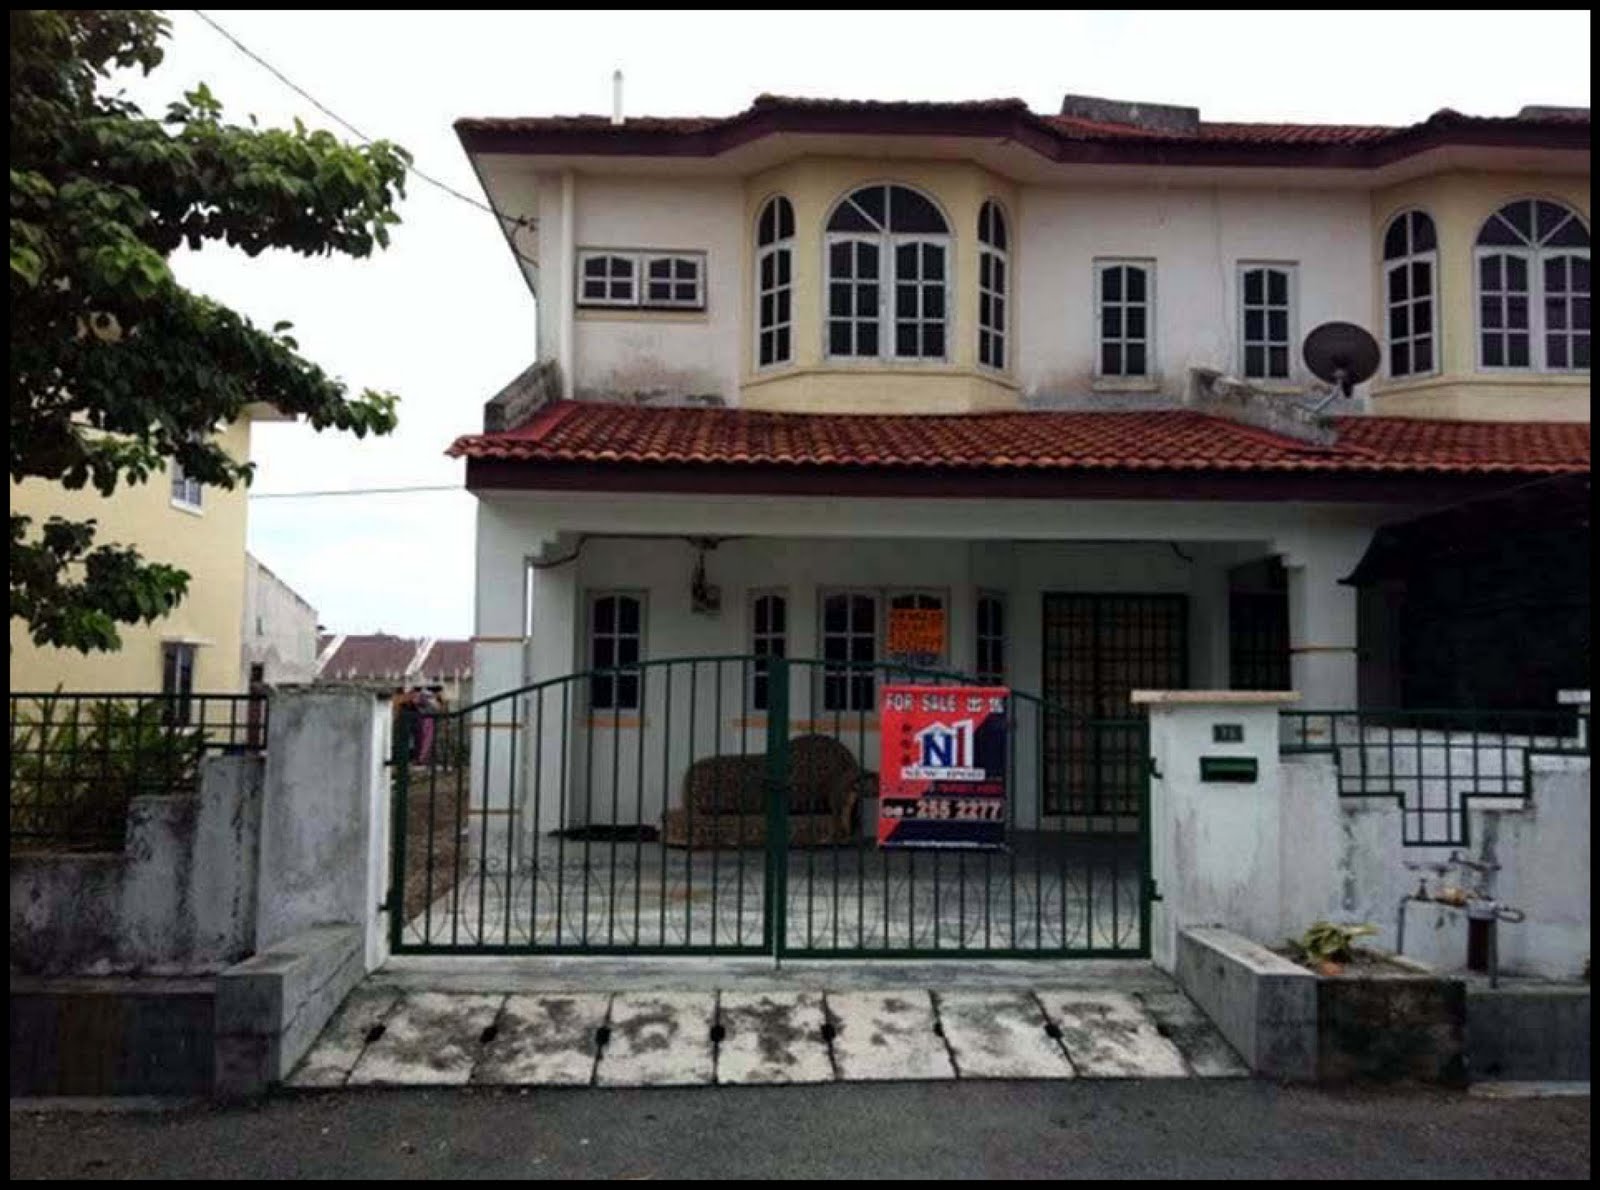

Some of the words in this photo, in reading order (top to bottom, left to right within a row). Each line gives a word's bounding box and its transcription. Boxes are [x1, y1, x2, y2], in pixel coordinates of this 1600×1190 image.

[886, 693, 913, 711] FOR
[922, 694, 957, 712] SALE
[956, 801, 1001, 820] 2277
